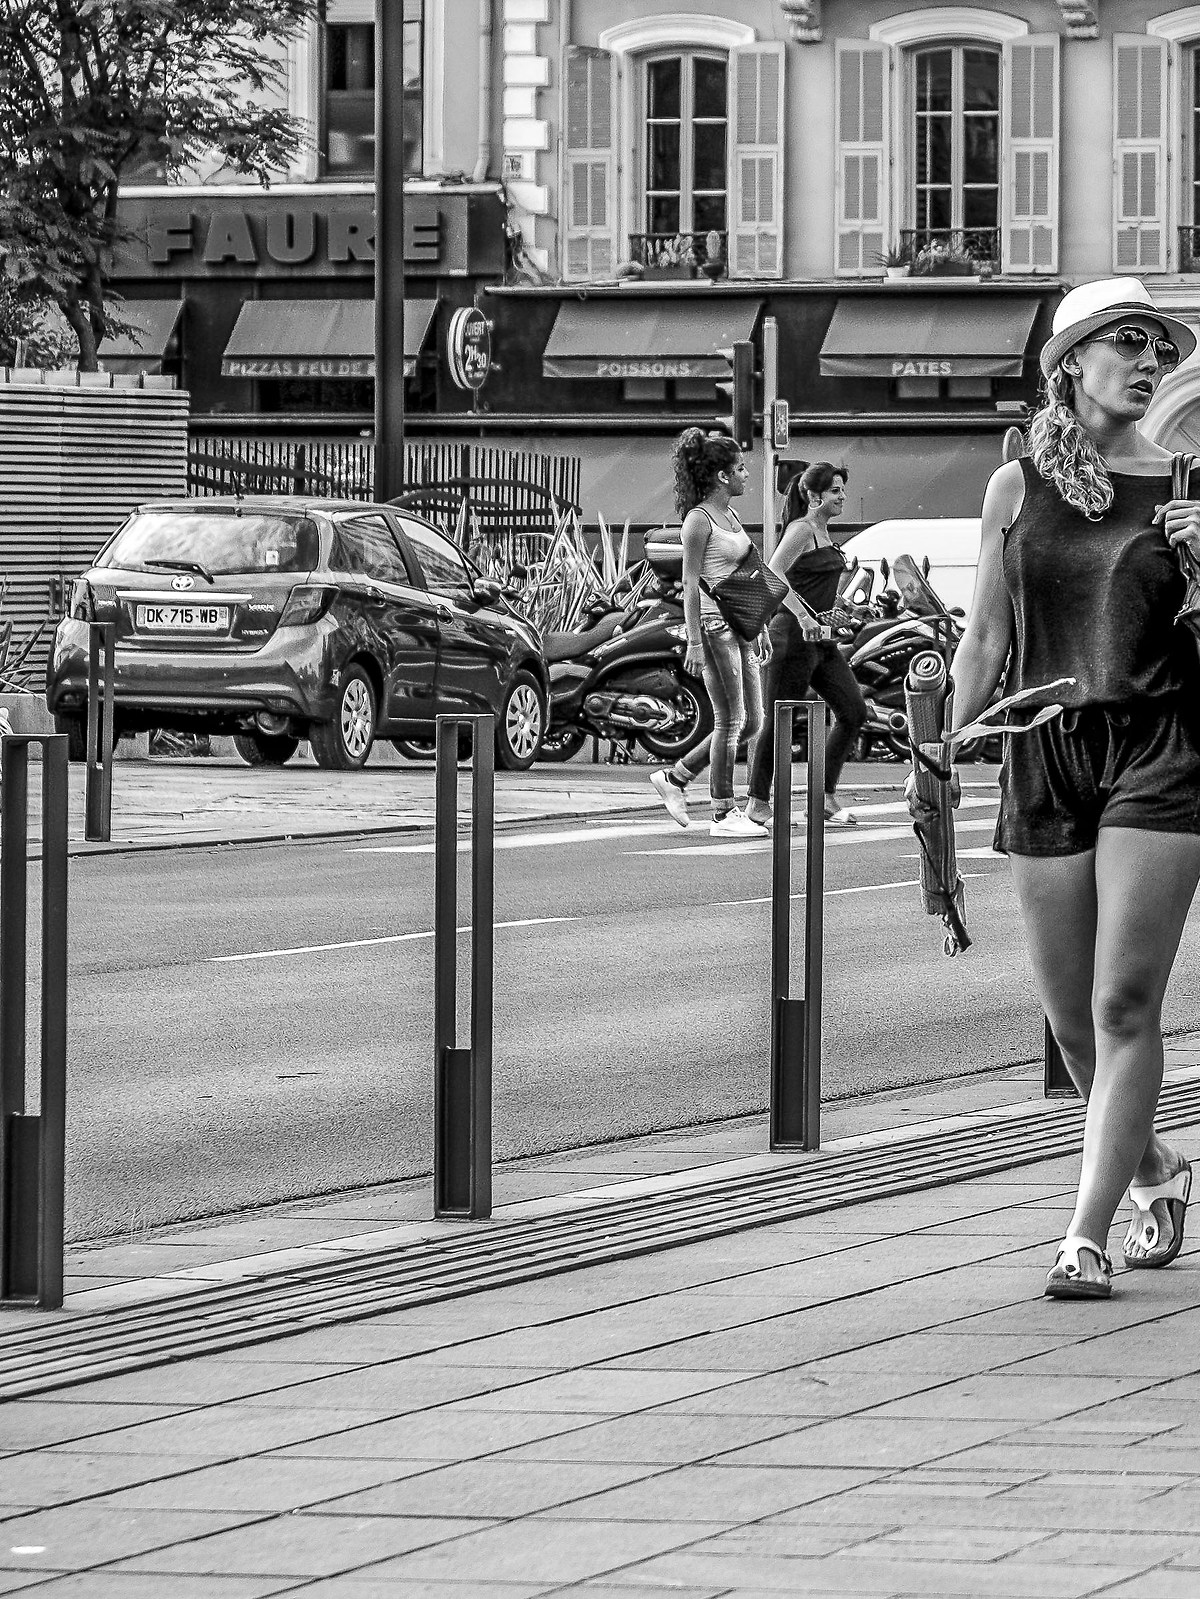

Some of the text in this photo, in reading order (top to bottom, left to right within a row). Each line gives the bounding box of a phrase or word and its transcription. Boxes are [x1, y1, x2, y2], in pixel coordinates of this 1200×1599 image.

[150, 212, 440, 263] FAURE
[229, 361, 293, 376] PIZZAS
[298, 361, 332, 376] FEU
[338, 361, 362, 376] DE
[597, 362, 691, 377] POISSONS
[892, 361, 952, 375] PATES
[146, 608, 218, 624] DK-715-WB
